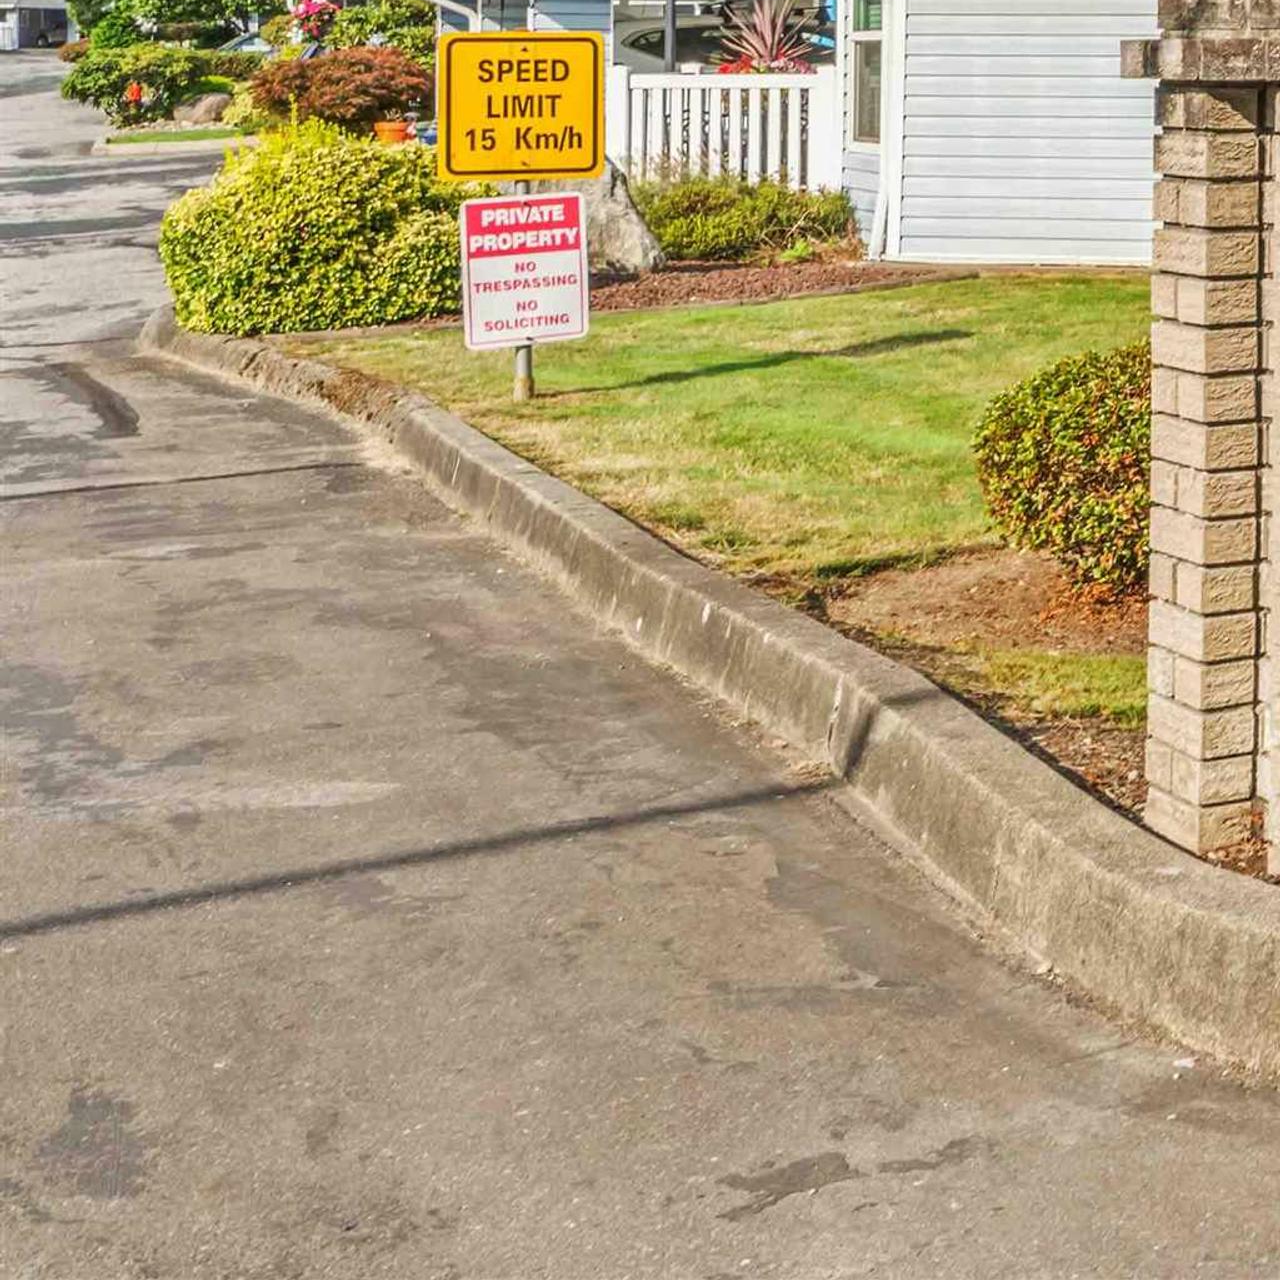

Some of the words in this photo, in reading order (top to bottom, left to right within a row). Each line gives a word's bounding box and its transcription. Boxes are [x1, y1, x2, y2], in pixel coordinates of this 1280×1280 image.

[477, 59, 570, 83] SPEED
[486, 95, 562, 119] LIMIT
[465, 128, 496, 151] 15
[515, 126, 583, 151] Km/h
[480, 204, 565, 226] PRIVATE
[469, 227, 579, 253] PROPERTY
[514, 262, 537, 273] NO
[473, 274, 578, 294] TRESPASSING
[516, 300, 539, 312] NO
[484, 314, 571, 333] SOLICITING
